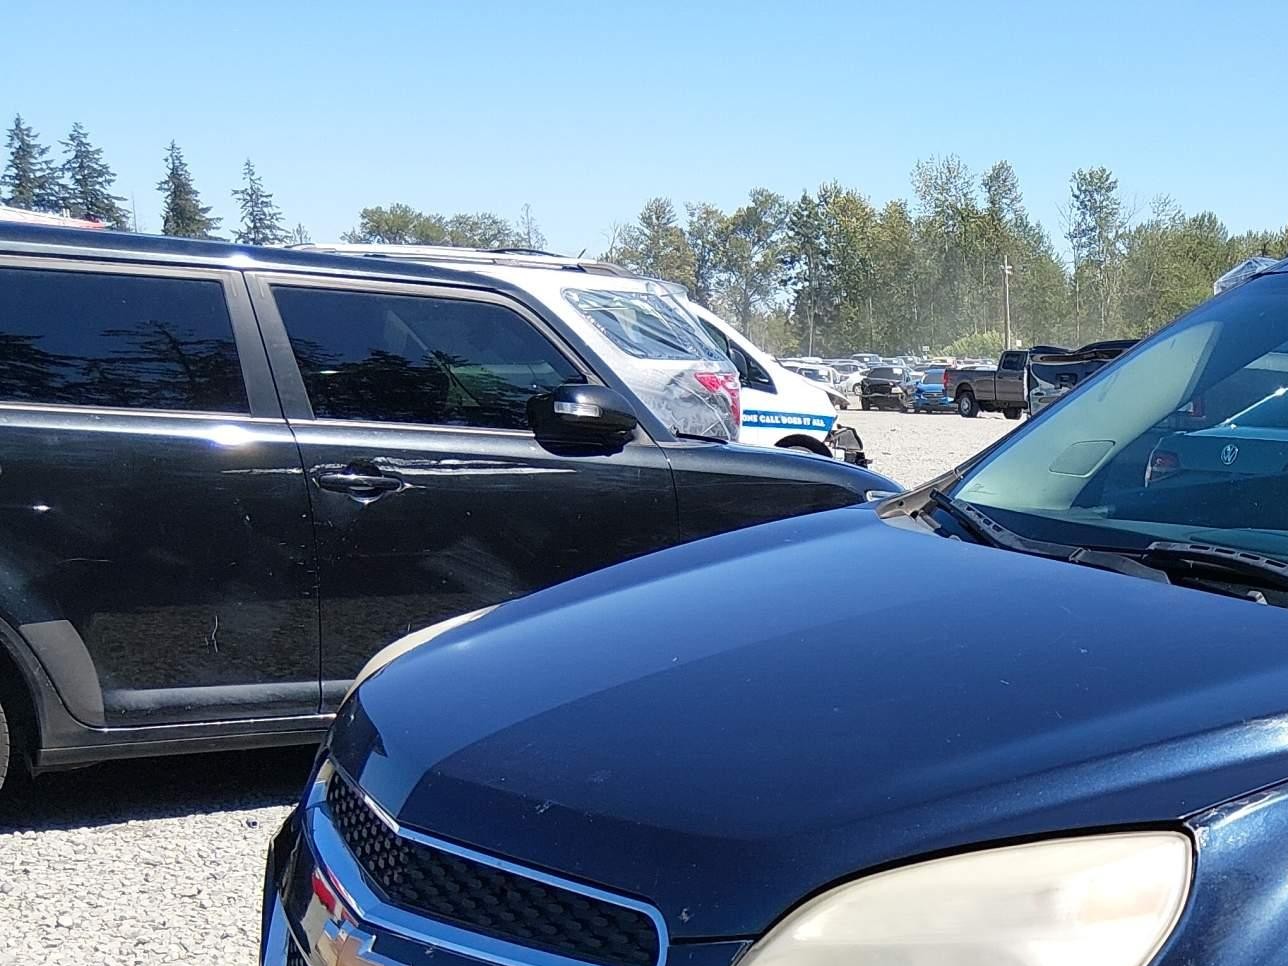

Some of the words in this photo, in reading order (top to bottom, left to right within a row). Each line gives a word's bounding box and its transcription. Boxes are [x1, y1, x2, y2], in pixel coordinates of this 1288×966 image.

[759, 414, 780, 424] CALL
[781, 415, 802, 425] DOES
[803, 417, 811, 426] IT
[812, 418, 826, 427] ALL
